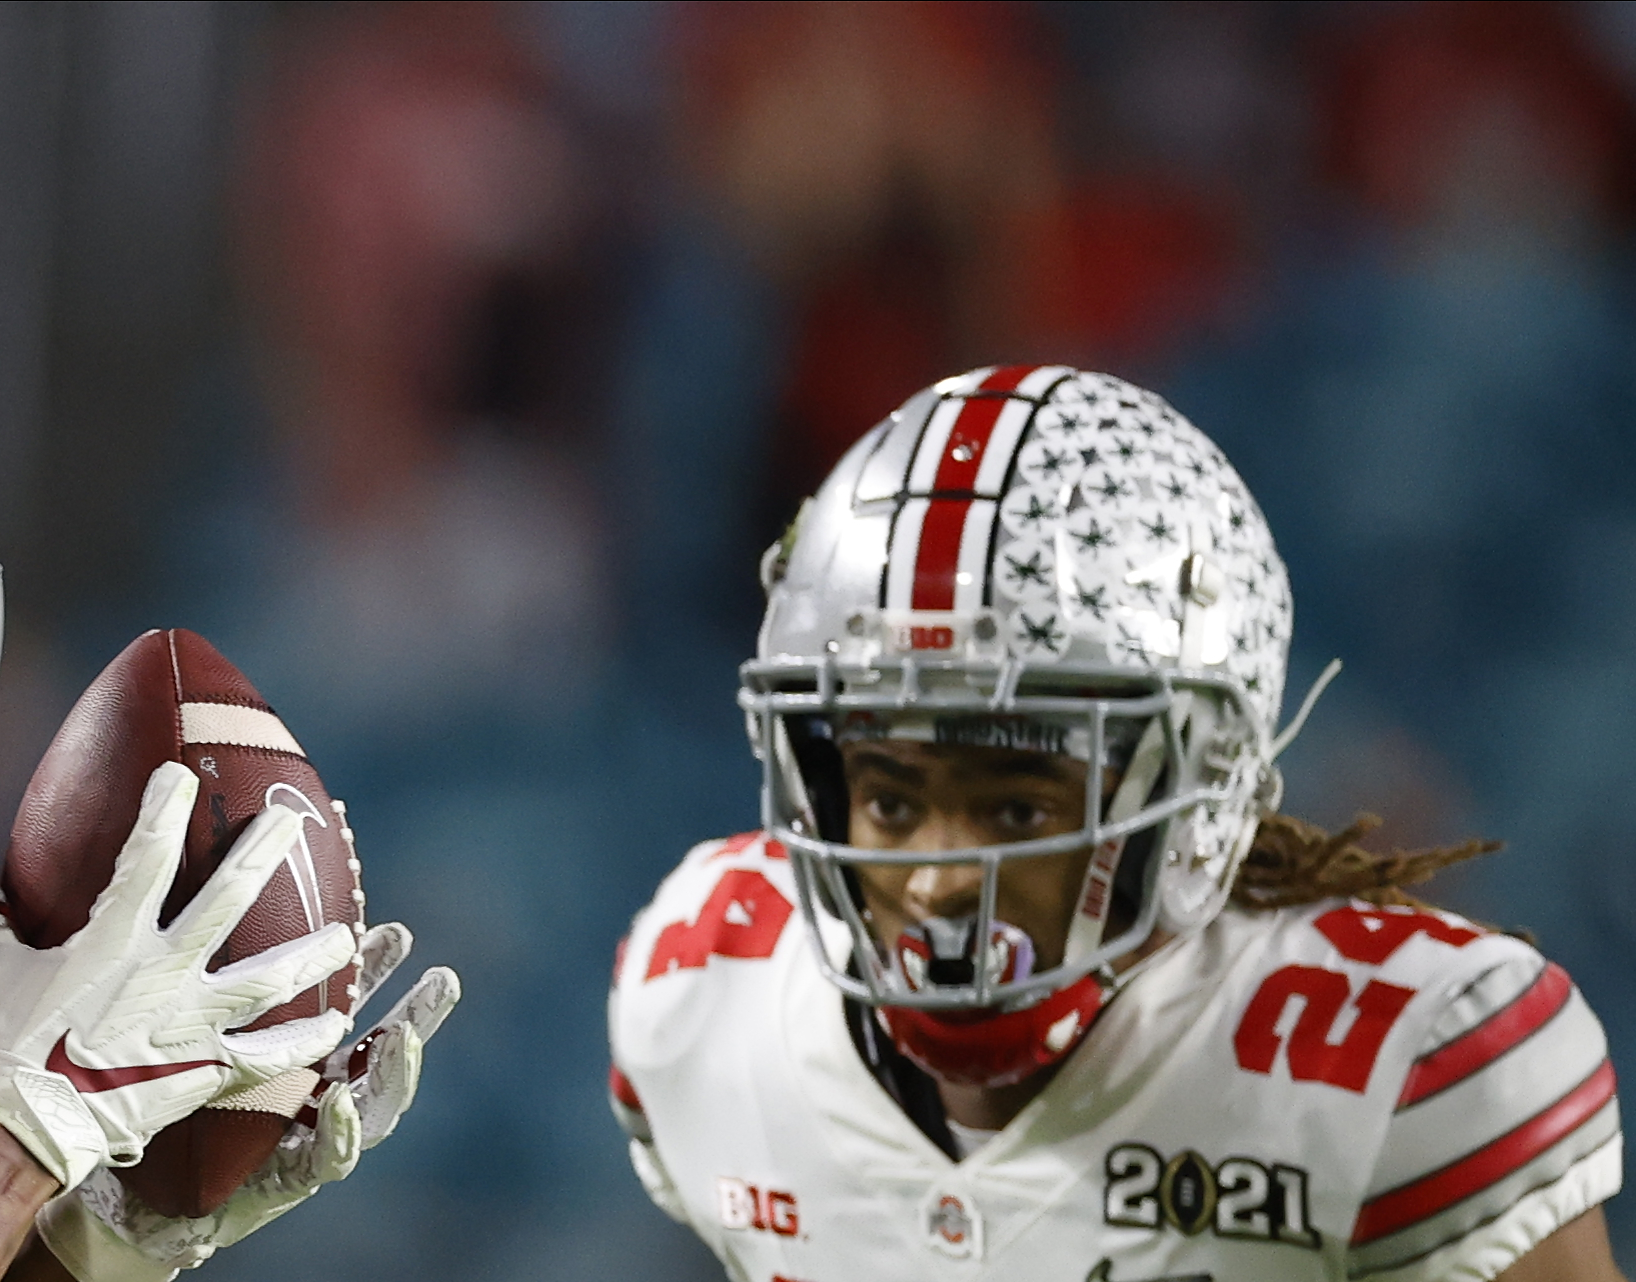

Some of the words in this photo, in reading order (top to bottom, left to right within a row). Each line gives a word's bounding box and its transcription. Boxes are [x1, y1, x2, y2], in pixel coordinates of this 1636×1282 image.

[1232, 904, 1486, 1094] 24
[717, 1176, 800, 1238] B1G
[1103, 1142, 1321, 1249] 2021
